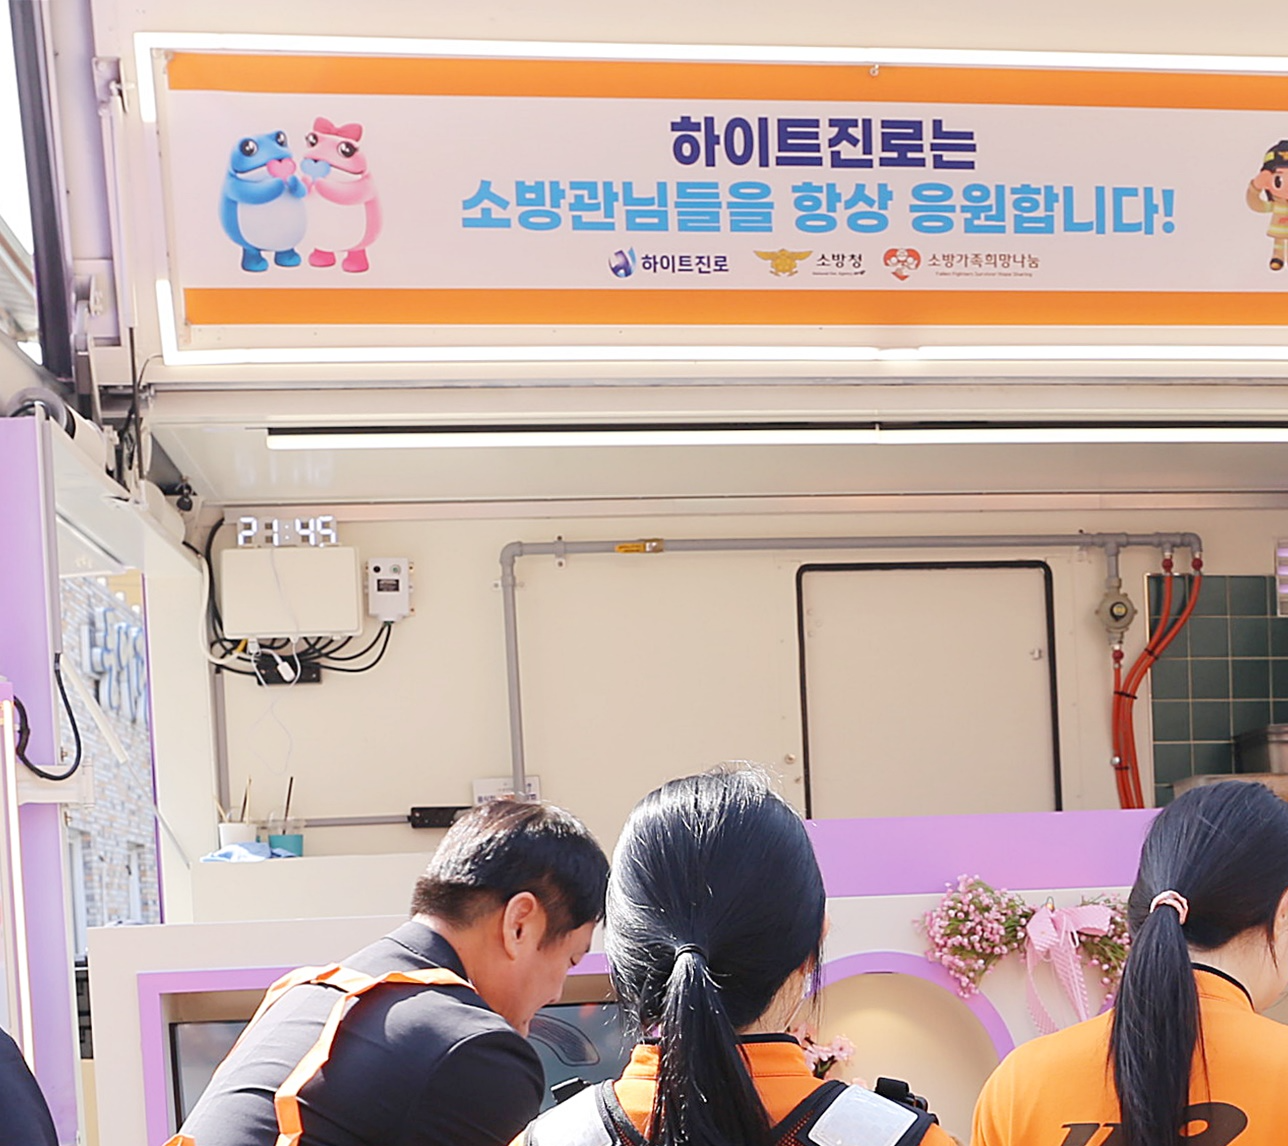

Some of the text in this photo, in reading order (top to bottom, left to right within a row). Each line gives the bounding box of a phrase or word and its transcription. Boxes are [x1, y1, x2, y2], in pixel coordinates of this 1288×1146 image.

[671, 116, 977, 170] 하이트진로는
[462, 180, 1175, 235] 소방관님들을 항상 응원합니다!
[641, 254, 729, 274] 하이트진로
[816, 253, 862, 269] 소방청
[928, 253, 1040, 269] 소방가족희망나눔
[238, 516, 337, 547] 21:45
